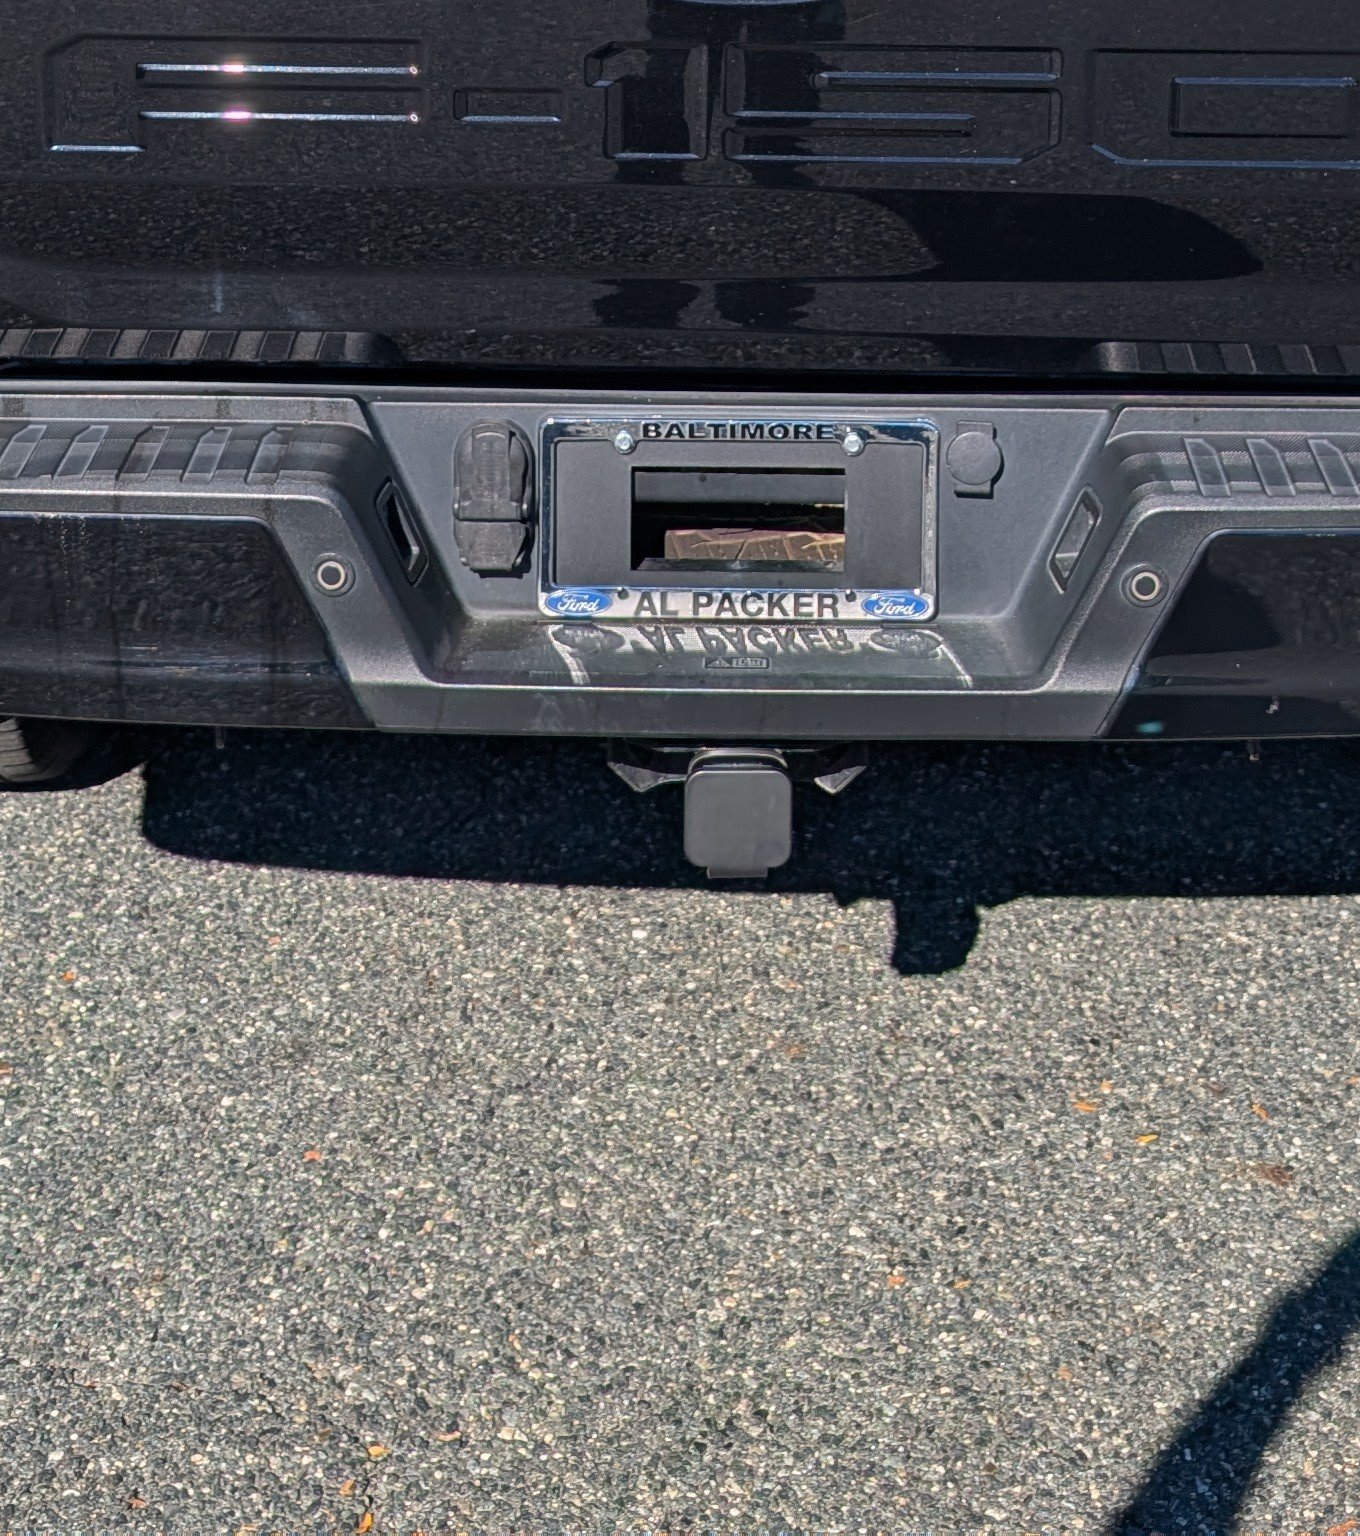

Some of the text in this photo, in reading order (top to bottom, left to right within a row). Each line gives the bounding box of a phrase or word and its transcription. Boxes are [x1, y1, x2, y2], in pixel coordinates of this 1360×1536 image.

[641, 422, 836, 441] BALTIMORE
[556, 593, 601, 612] Ford
[634, 590, 840, 619] AL PACKER
[873, 597, 917, 615] Ford
